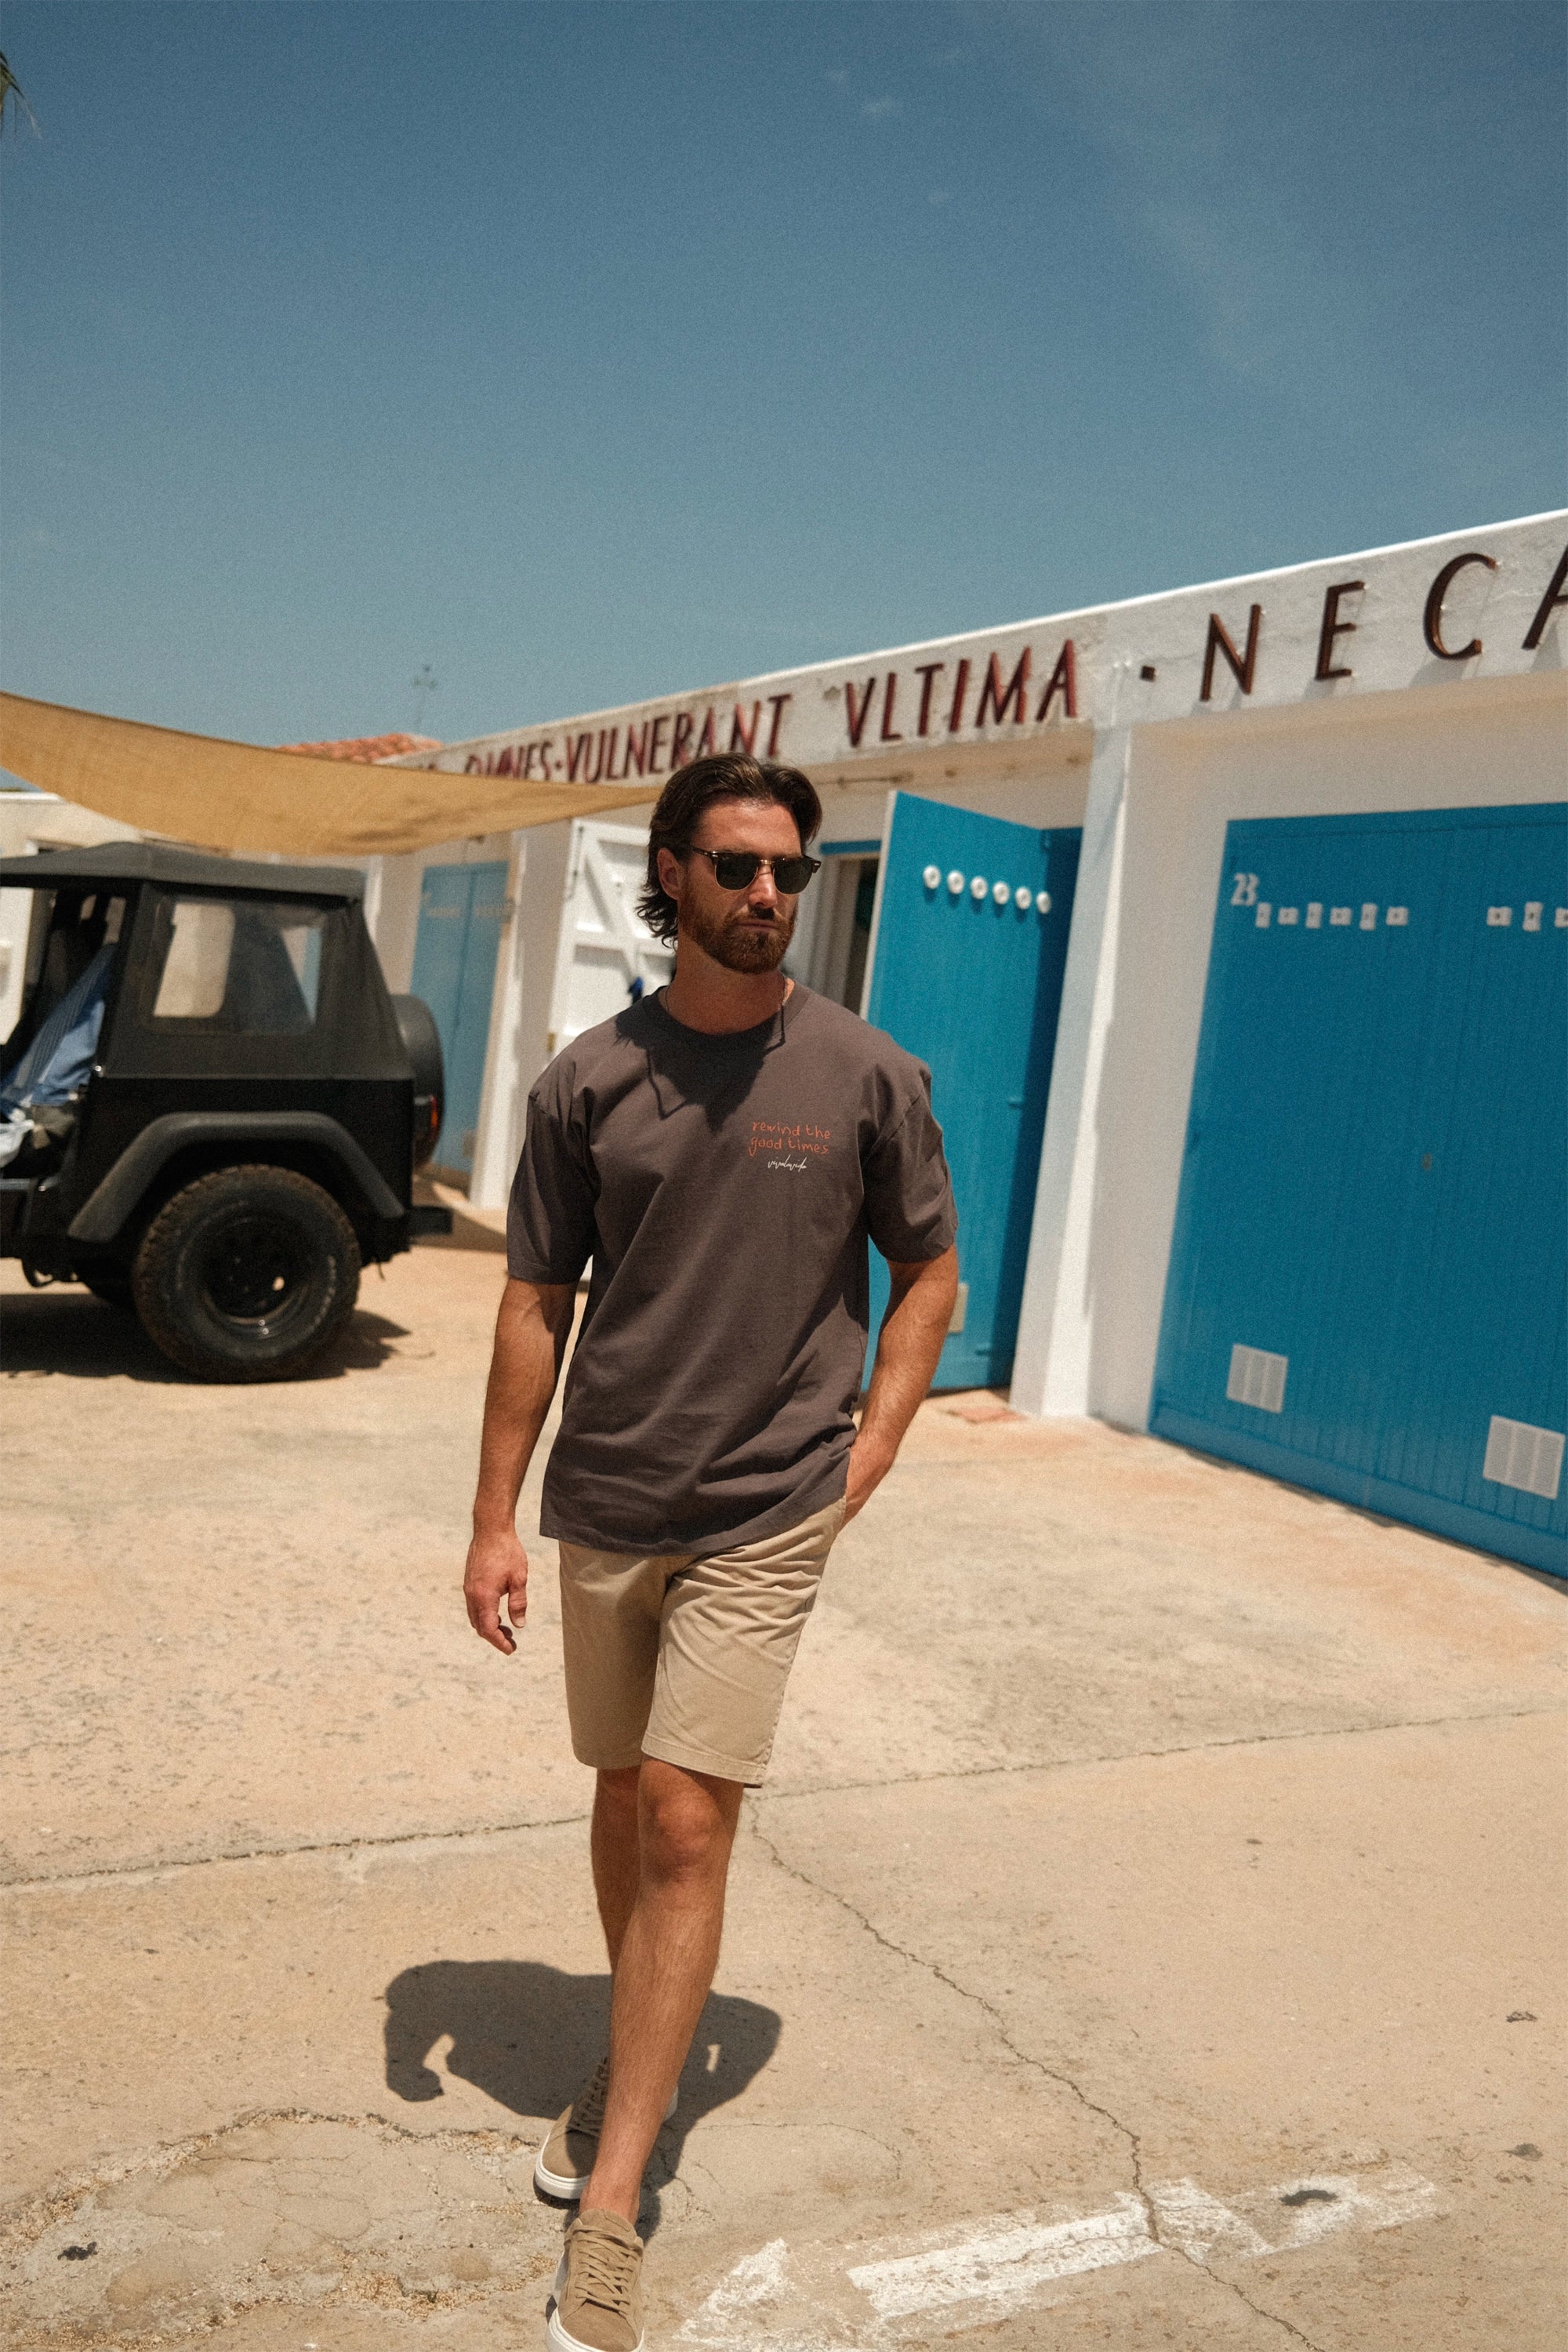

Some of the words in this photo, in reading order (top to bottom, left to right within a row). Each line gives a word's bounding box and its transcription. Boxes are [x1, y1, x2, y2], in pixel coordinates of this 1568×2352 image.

[845, 639, 1077, 748] VLTIMA
[752, 1121, 800, 1136] rewind
[805, 1123, 831, 1139] the
[748, 1136, 783, 1157] good
[788, 1136, 829, 1155] times
